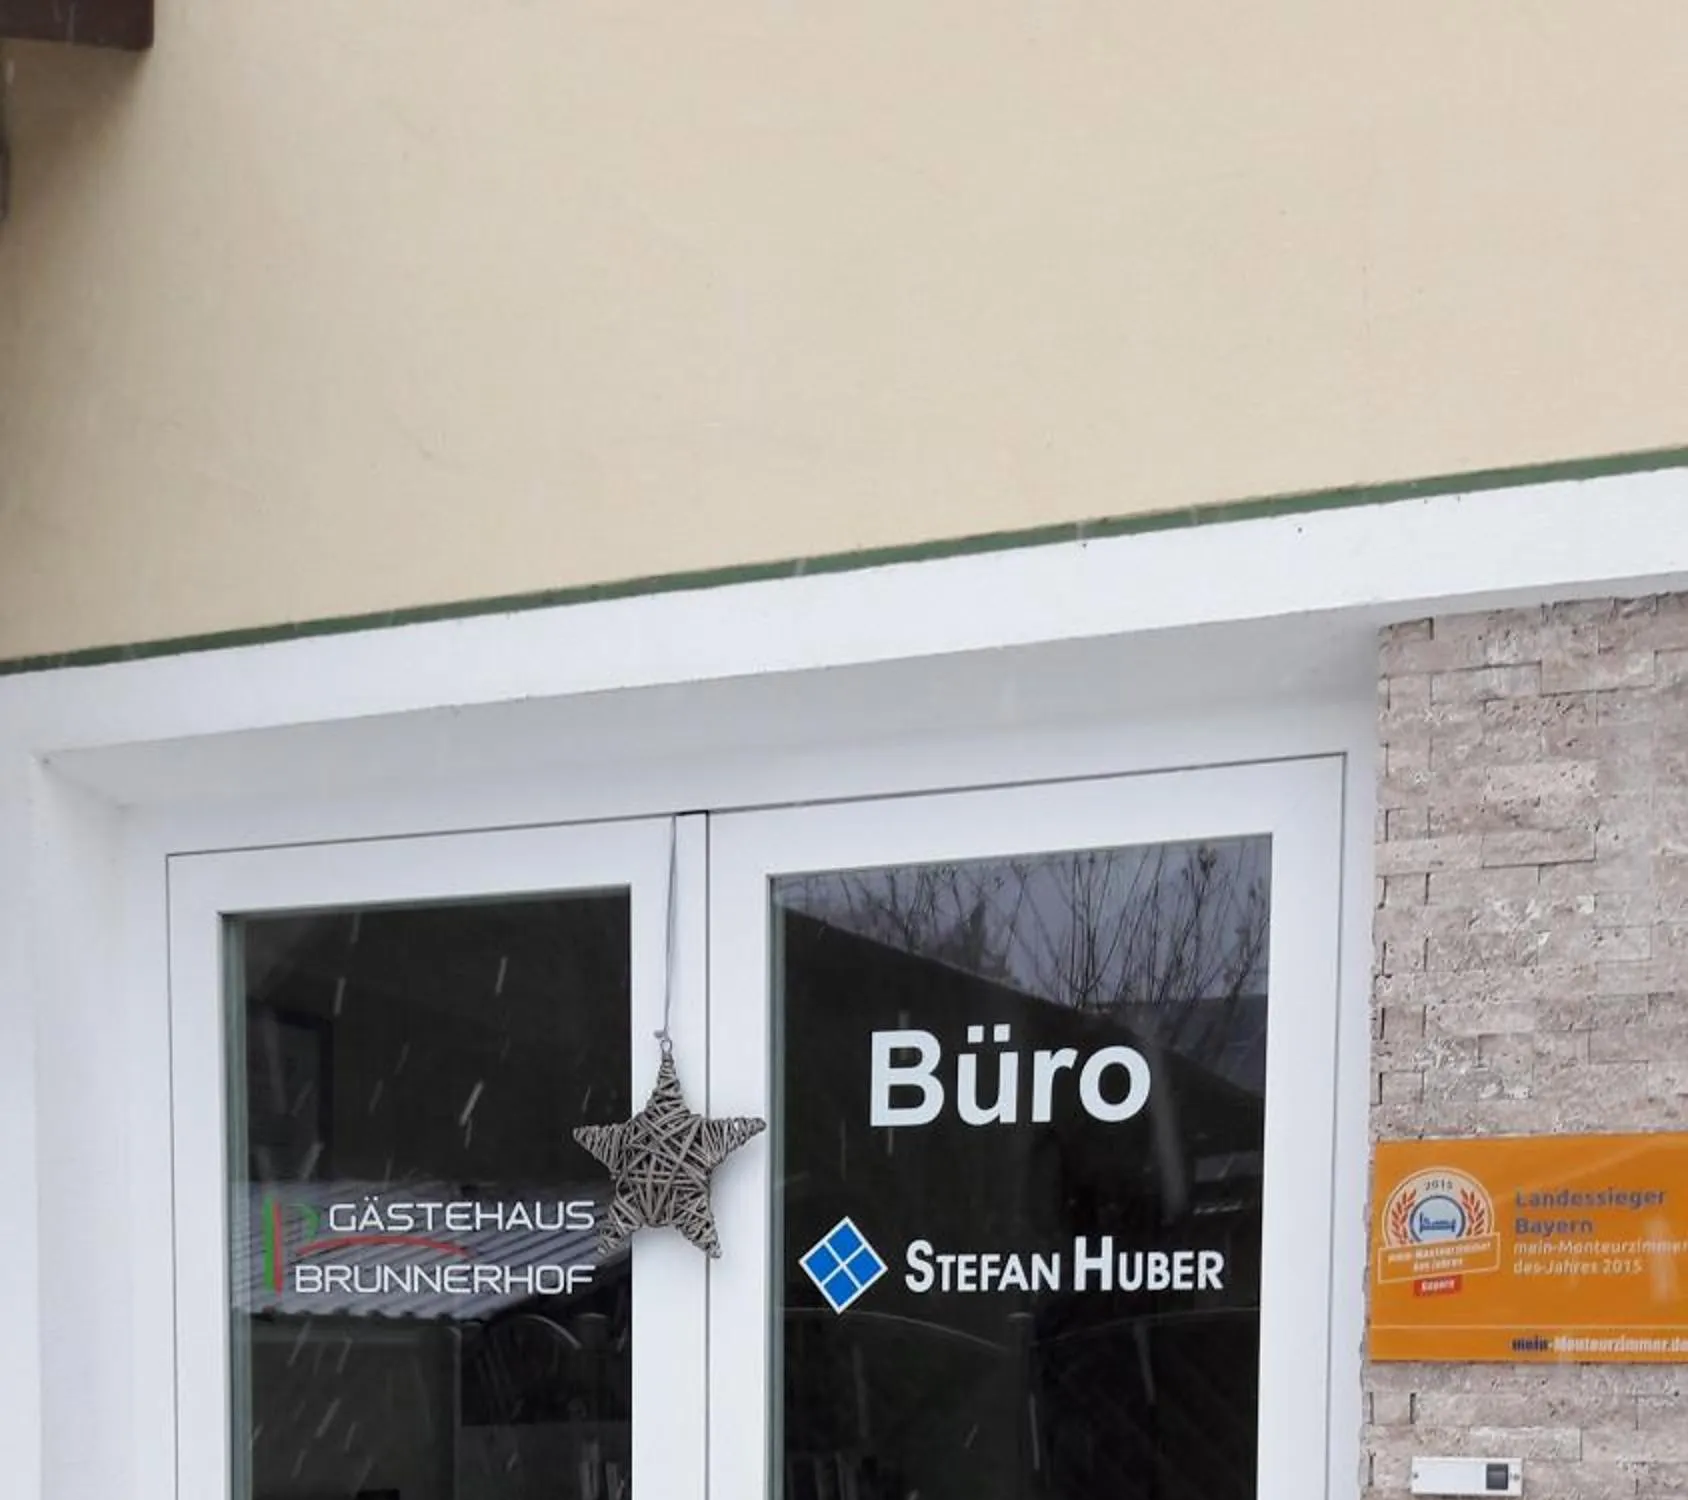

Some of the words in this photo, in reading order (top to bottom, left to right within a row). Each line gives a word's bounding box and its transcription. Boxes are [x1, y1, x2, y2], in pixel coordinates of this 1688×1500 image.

[870, 1024, 1151, 1127] Büro
[1515, 1190, 1666, 1208] Landessieger
[329, 1197, 594, 1231] GÄSTEHAUS
[1514, 1217, 1593, 1236] Bayern
[1603, 1259, 1643, 1275] 2015
[295, 1265, 595, 1294] BRUNNERHOF
